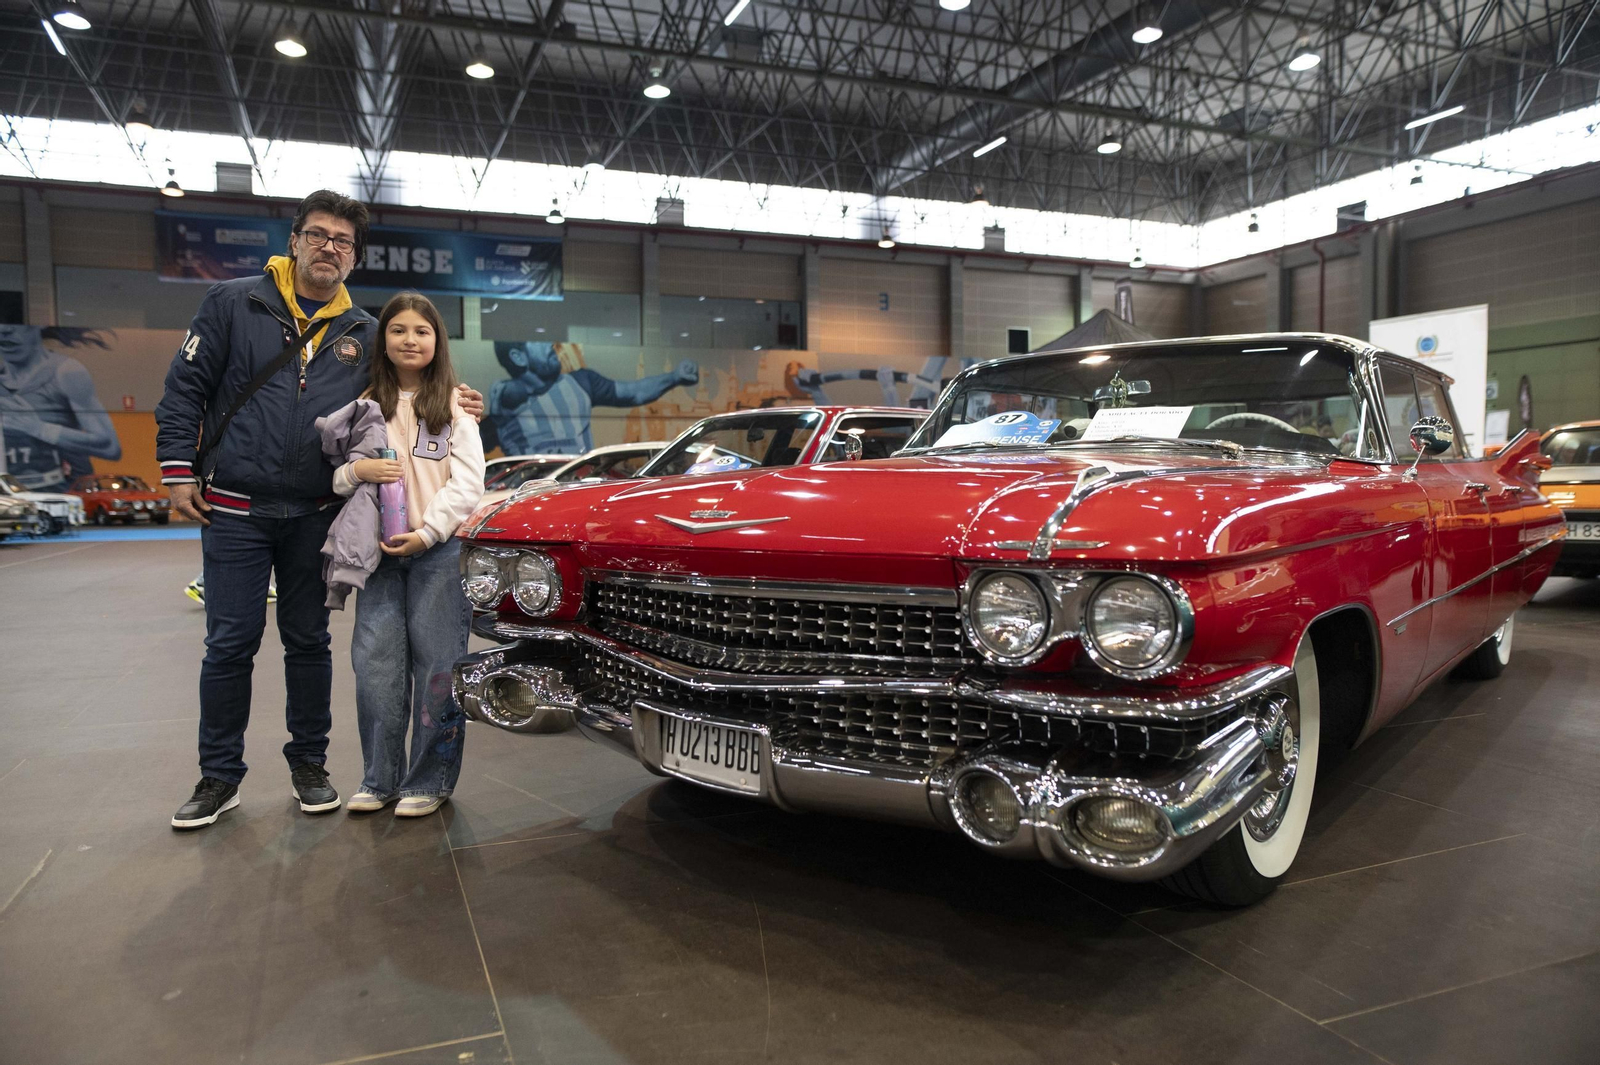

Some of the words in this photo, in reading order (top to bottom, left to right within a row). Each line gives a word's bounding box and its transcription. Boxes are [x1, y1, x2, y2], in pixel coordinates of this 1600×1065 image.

[356, 244, 454, 275] ENSE
[994, 413, 1022, 425] 87
[412, 418, 452, 462] B
[6, 447, 31, 464] 17
[716, 457, 733, 465] 85
[666, 716, 677, 754] H
[680, 719, 720, 765] 0213
[725, 728, 760, 774] BBB
